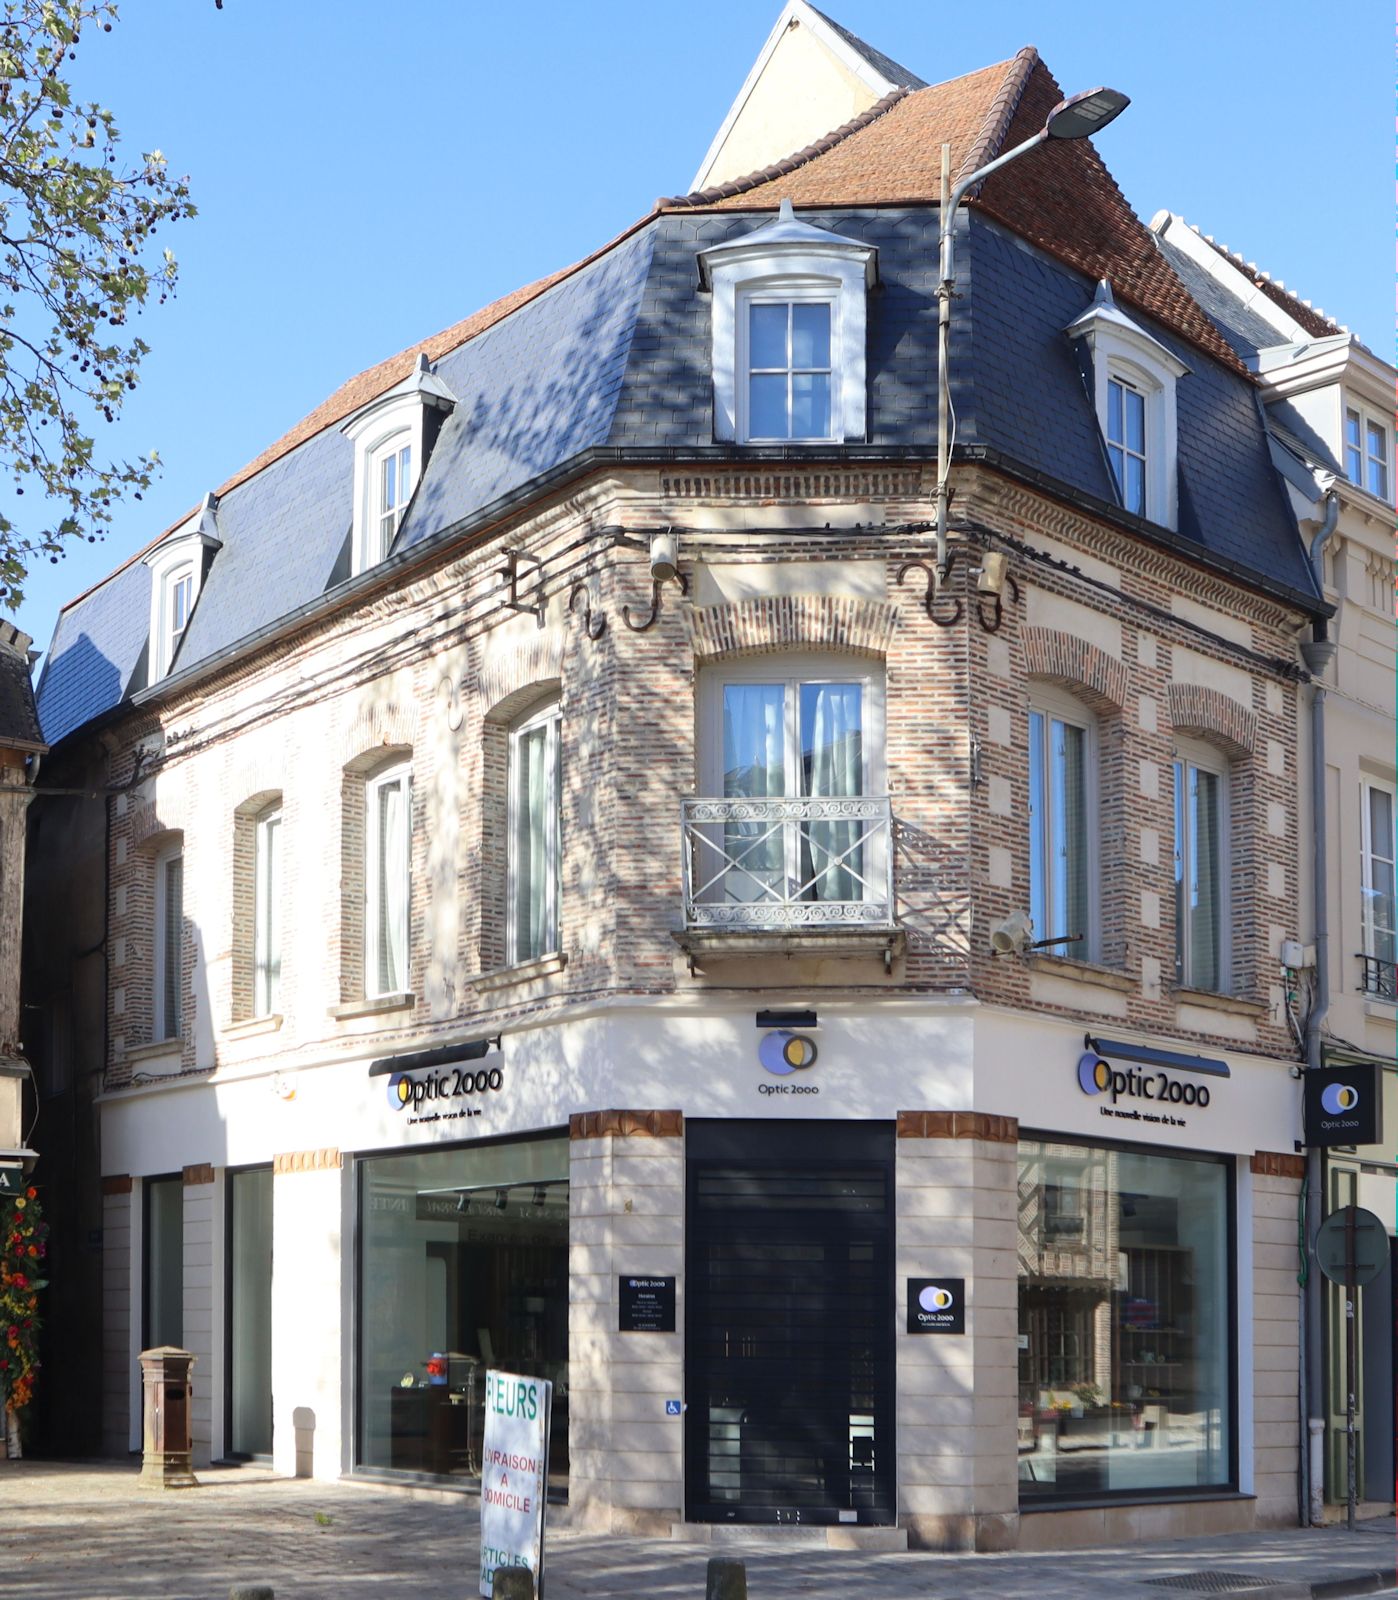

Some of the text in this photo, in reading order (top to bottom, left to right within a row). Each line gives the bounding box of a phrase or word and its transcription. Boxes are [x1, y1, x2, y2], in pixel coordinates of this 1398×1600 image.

[452, 1068, 503, 1097] 2000
[758, 1084, 819, 1096] Optic 2000
[1157, 1073, 1210, 1108] 2000
[1321, 1121, 1340, 1130] Optic
[918, 1313, 936, 1322] Optic
[500, 1472, 508, 1488] A
